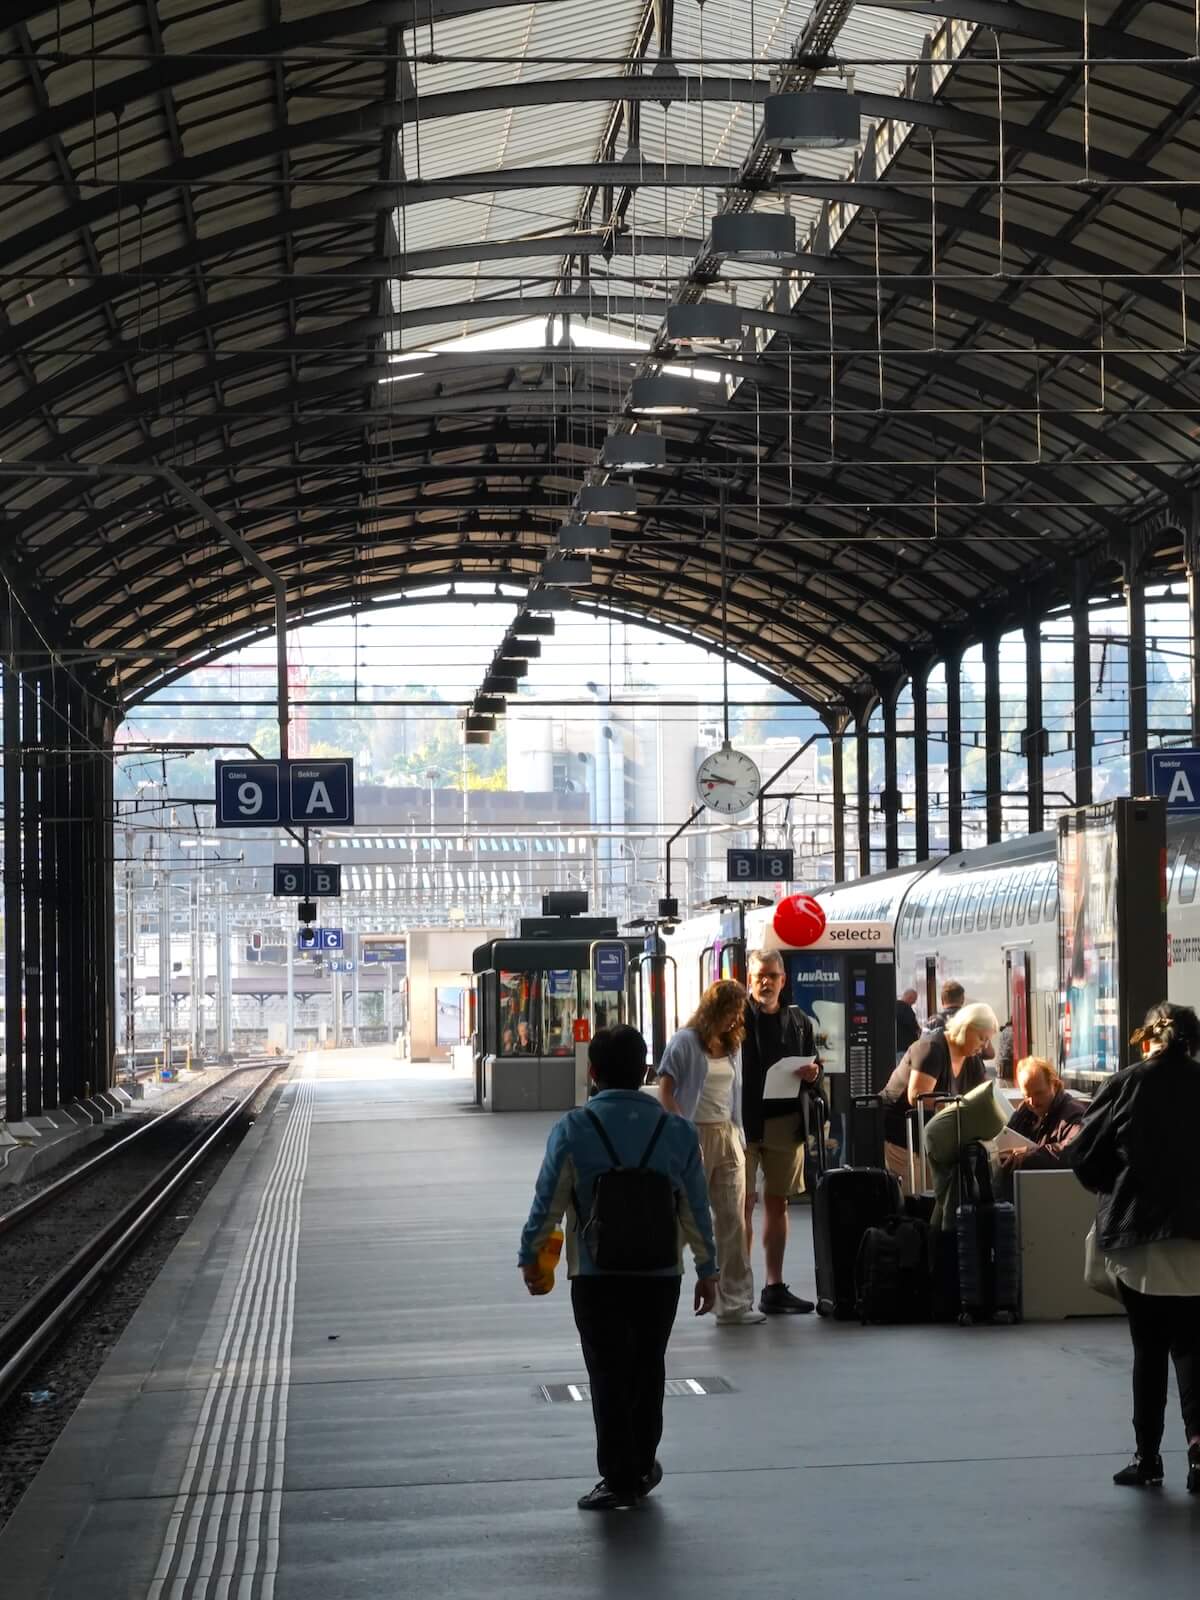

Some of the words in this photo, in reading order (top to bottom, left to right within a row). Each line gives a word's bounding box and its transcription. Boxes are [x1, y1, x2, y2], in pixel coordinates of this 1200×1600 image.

[1168, 770, 1195, 802] A
[238, 782, 263, 815] 9
[305, 781, 334, 814] A
[737, 860, 750, 876] B
[771, 860, 783, 876] 8
[284, 874, 297, 891] 9
[317, 874, 331, 891] B
[327, 934, 337, 947] C
[829, 928, 881, 941] selecta
[797, 969, 841, 982] LAVAZZA
